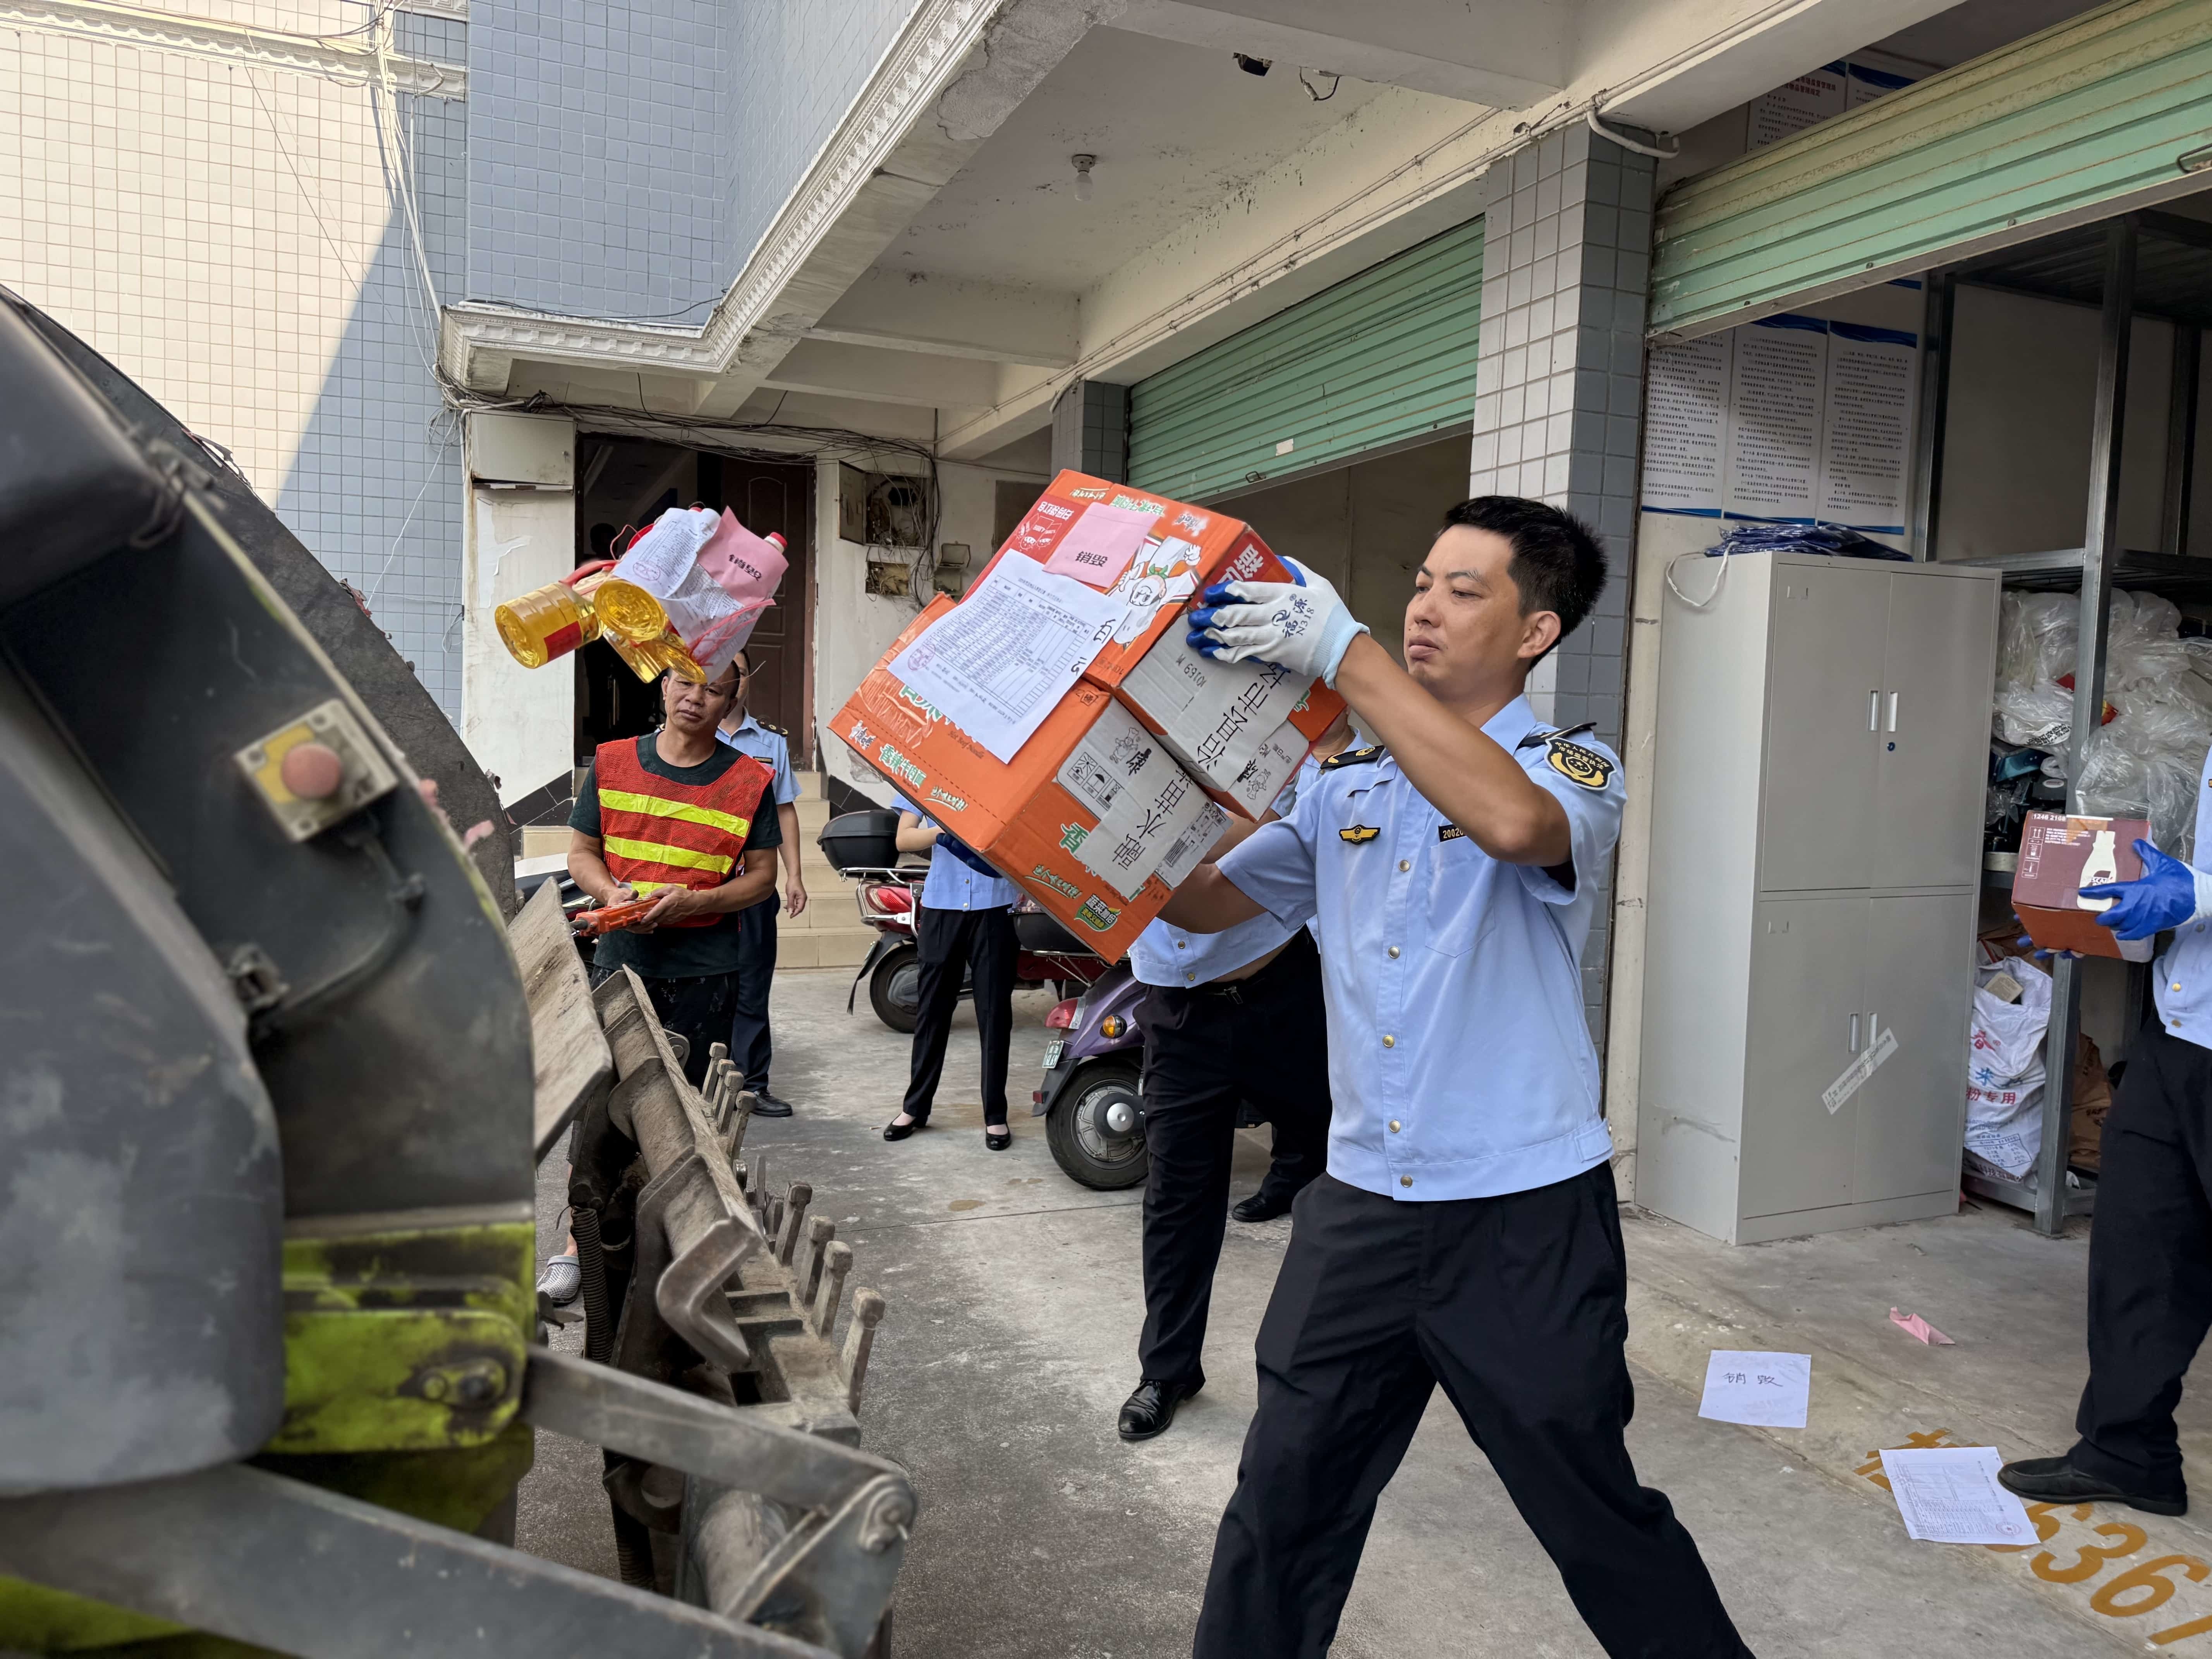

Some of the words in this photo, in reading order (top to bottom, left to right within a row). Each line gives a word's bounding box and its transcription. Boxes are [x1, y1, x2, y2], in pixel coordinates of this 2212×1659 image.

[728, 554, 762, 582] 销毁
[1075, 551, 1108, 567] 销毁
[1296, 607, 1315, 636] N318
[878, 743, 927, 789] 香辣牛肉面
[1555, 741, 1611, 768] 中华人民共和国
[1085, 893, 1118, 925] 蔬菜加倍
[1966, 1087, 2016, 1104] 粉专用
[1721, 1370, 1783, 1388] 销毁
